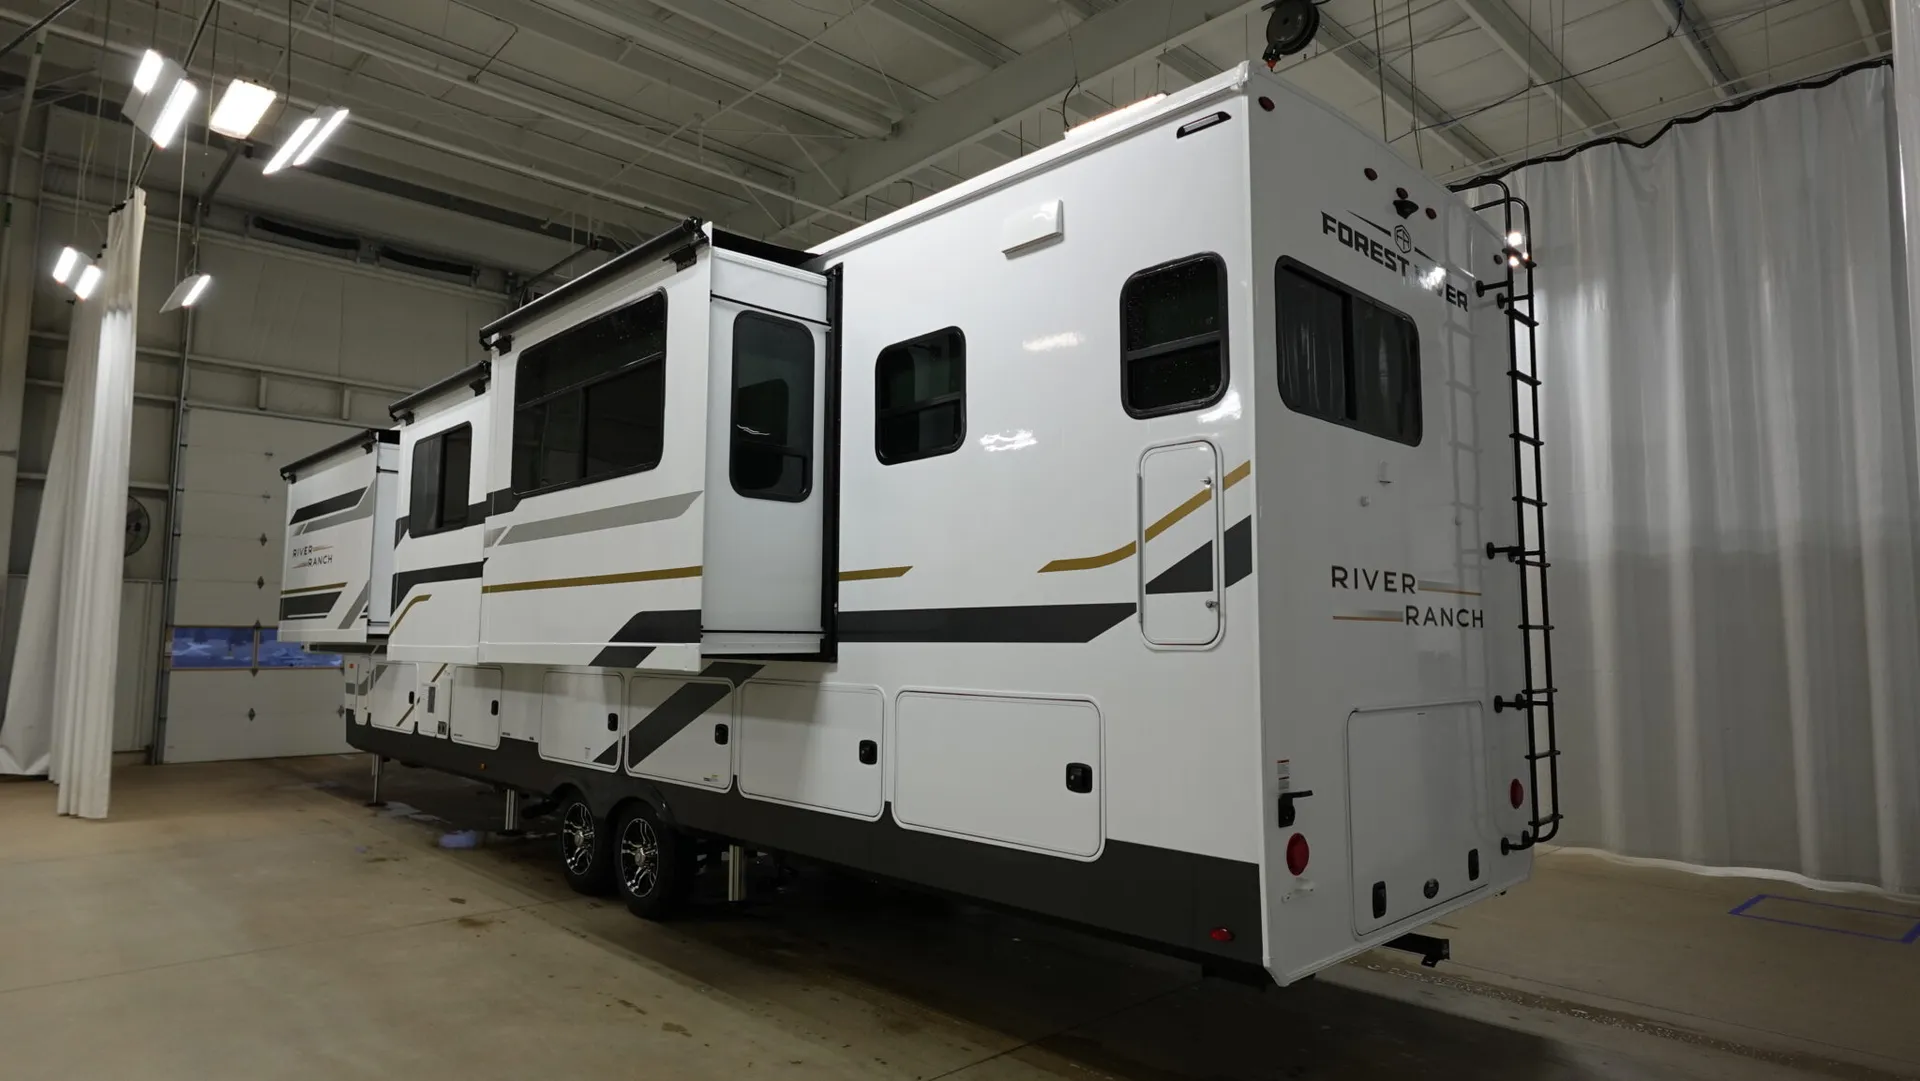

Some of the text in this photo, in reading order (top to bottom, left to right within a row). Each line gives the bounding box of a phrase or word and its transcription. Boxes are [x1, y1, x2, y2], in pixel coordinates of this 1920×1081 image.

[1321, 210, 1410, 277] FOREST
[292, 545, 313, 557] RIVER
[308, 554, 333, 567] RANCH
[1331, 565, 1416, 594] RIVER
[1405, 605, 1484, 628] RANCH
